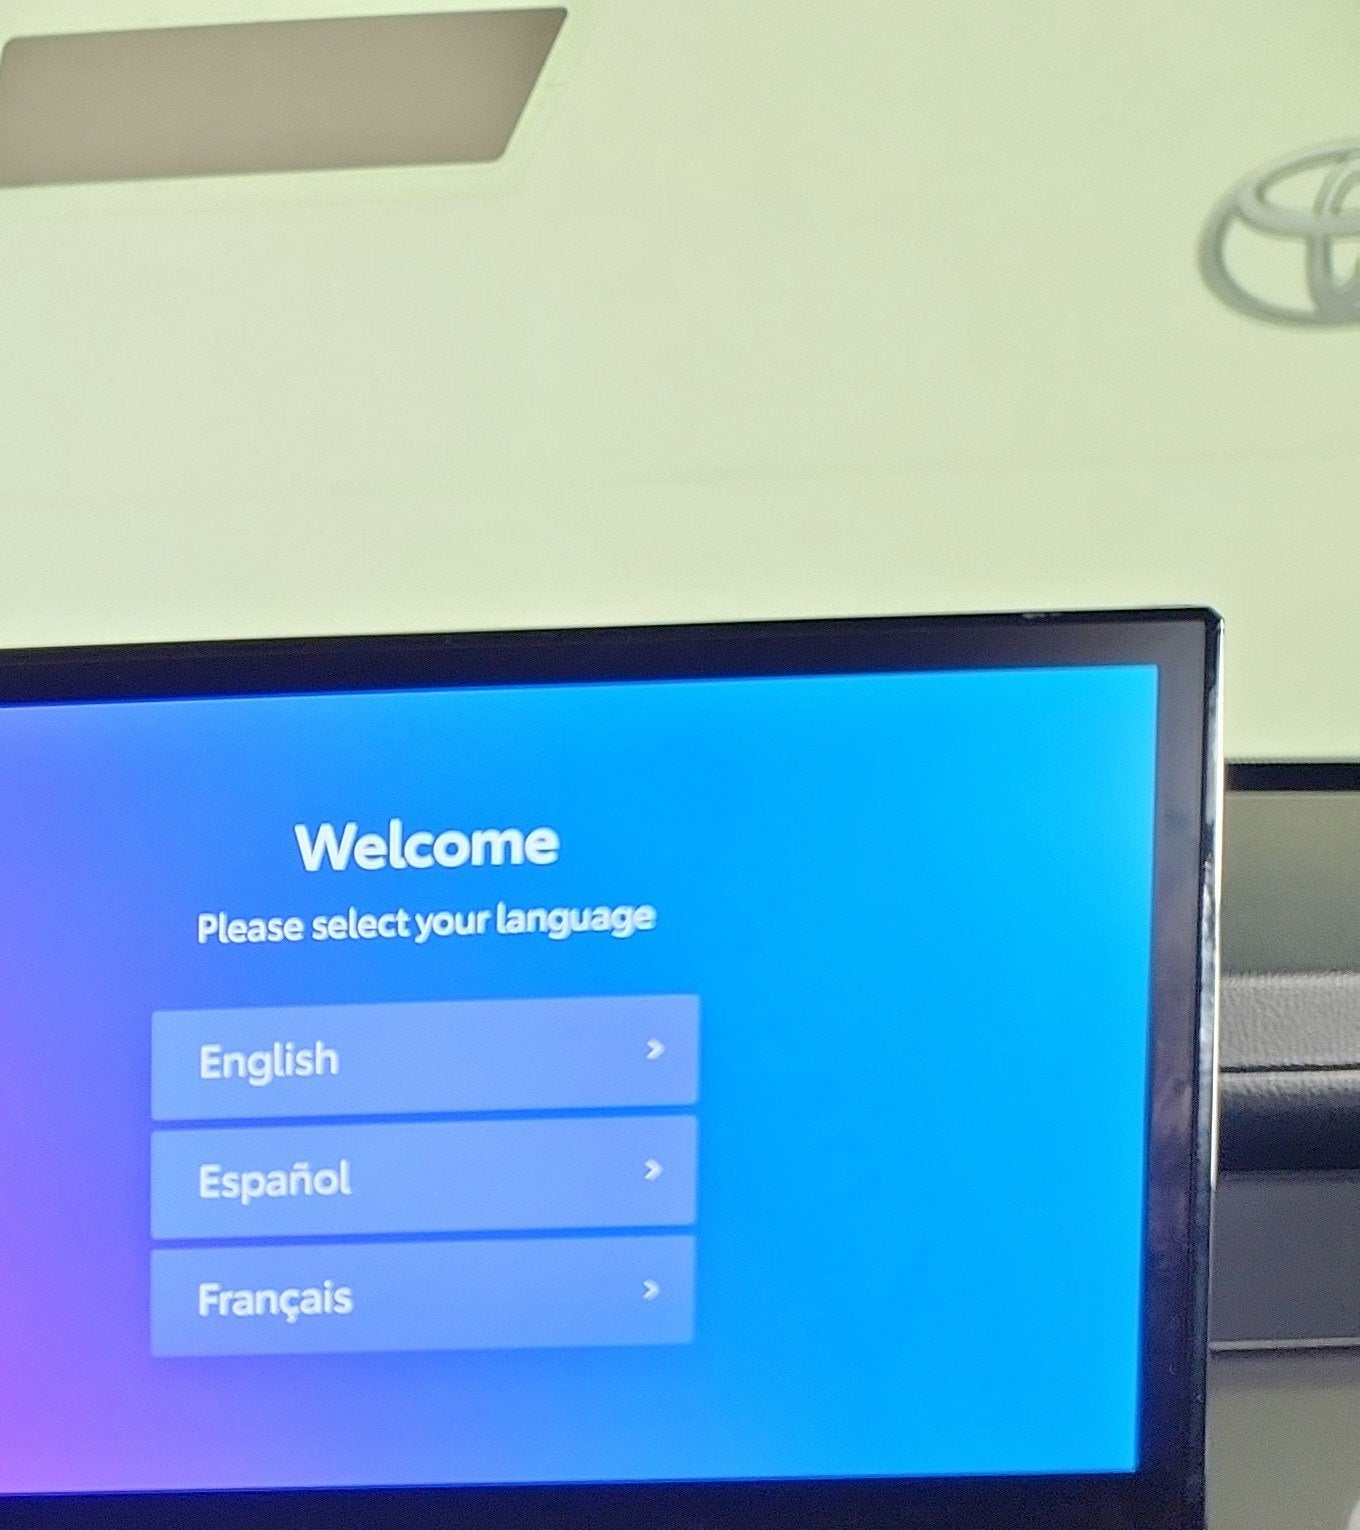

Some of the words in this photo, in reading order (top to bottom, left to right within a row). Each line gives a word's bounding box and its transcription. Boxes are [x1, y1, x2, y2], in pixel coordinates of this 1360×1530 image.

[294, 818, 561, 872] Welcome
[197, 912, 304, 944] Please
[312, 907, 410, 940] select
[414, 908, 490, 943] your
[496, 902, 657, 940] language
[199, 1041, 339, 1086] English
[199, 1159, 351, 1205] Español
[197, 1279, 353, 1323] Français
